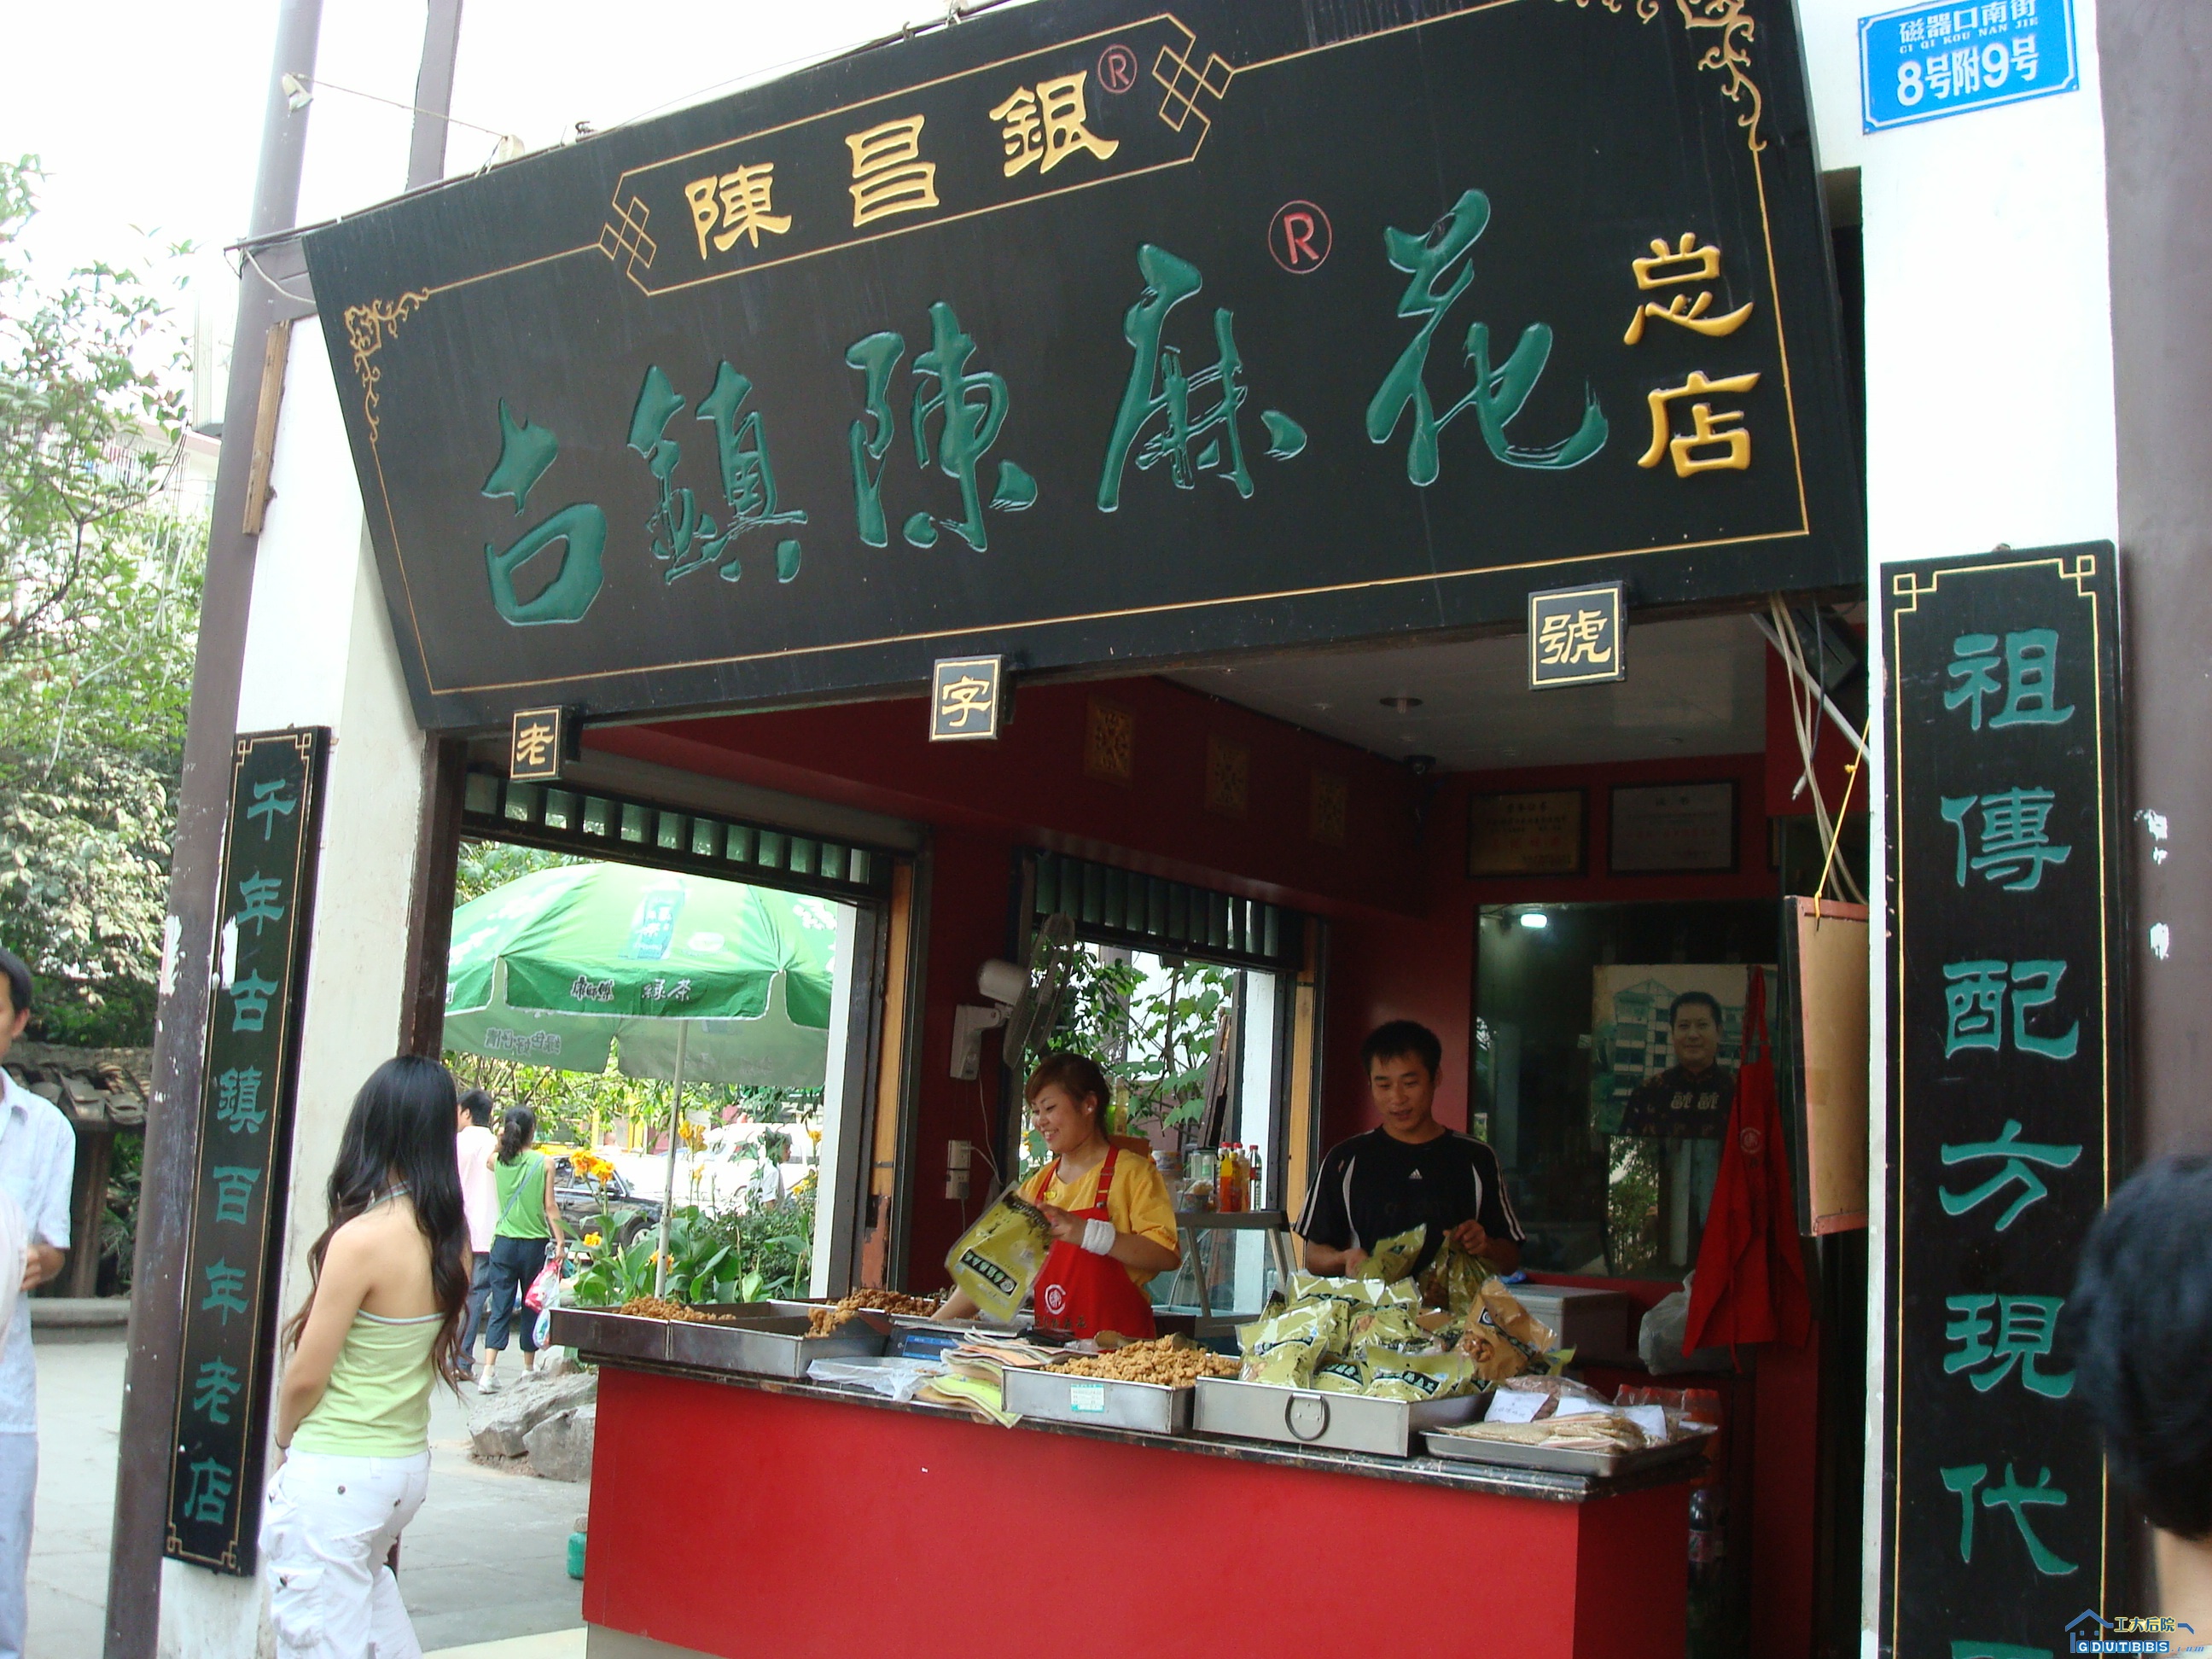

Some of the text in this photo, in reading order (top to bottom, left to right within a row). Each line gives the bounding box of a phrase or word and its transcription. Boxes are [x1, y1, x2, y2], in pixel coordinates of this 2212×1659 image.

[1899, 0, 2036, 44] 磁器口南街
[1900, 44, 1913, 54] CI
[1943, 32, 1971, 44] KOU
[1978, 24, 2007, 37] NAN
[2016, 16, 2039, 29] JIE
[1896, 33, 2040, 106] 8号附9号
[941, 675, 992, 727] 字
[516, 722, 555, 765] 老
[1939, 626, 2082, 1659] 祖傳配方現代
